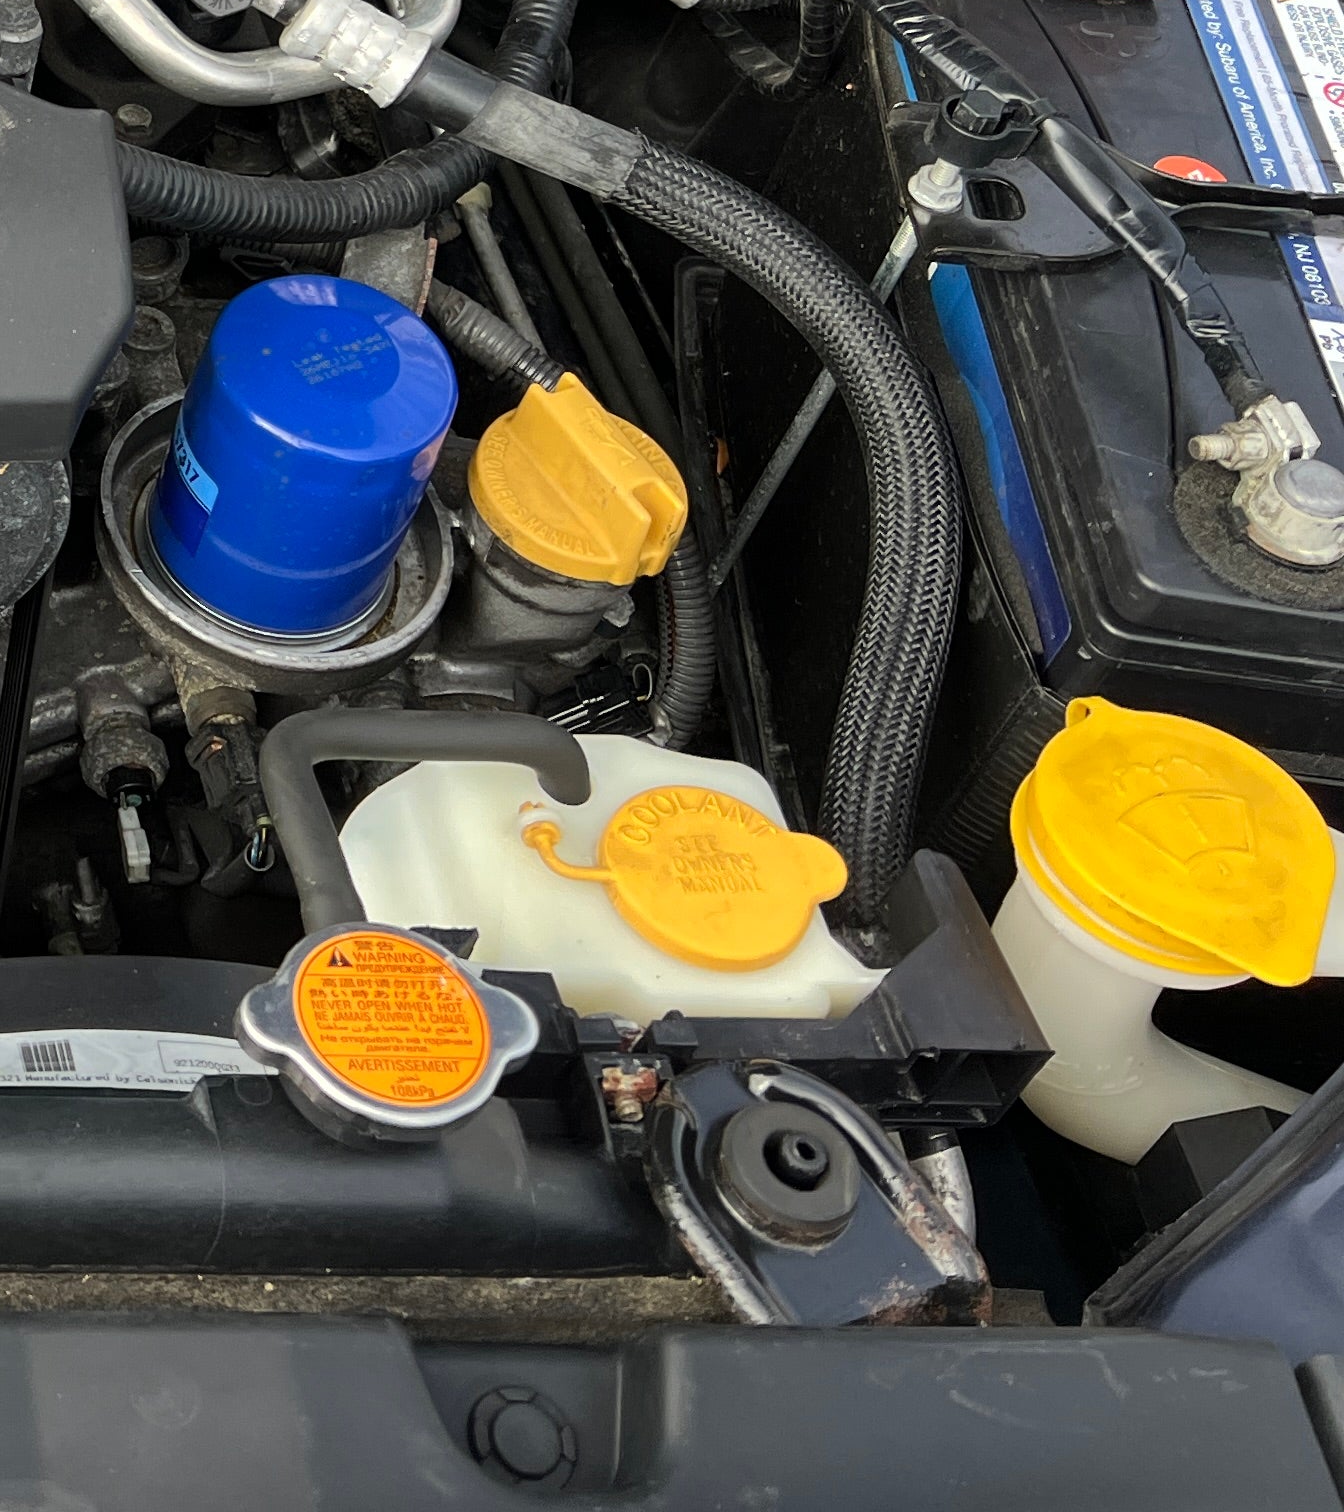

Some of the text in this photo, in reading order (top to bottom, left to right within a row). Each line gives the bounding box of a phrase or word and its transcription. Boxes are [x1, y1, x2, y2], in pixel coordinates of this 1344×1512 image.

[1215, 41, 1240, 88] Subaru
[1231, 86, 1249, 101] of
[1238, 101, 1268, 154] America,
[1260, 156, 1279, 180] Inc.
[1293, 243, 1315, 263] NJ
[1301, 265, 1332, 307] 08103
[484, 432, 510, 459] SEE
[524, 516, 596, 558] MANUAL
[618, 791, 778, 846] COOLANT
[674, 834, 717, 853] SEE
[677, 875, 763, 894] MANUAL
[352, 951, 425, 964] WARNING
[312, 999, 351, 1011] NEVER
[357, 1000, 391, 1011] OPEN
[395, 1001, 433, 1013] WHEN
[315, 1011, 328, 1021] NE
[332, 1011, 372, 1022] JAMAIS
[374, 1011, 414, 1023] OUVRIR
[348, 1058, 461, 1073] AVERTISSEMENT
[115, 1074, 130, 1084] by
